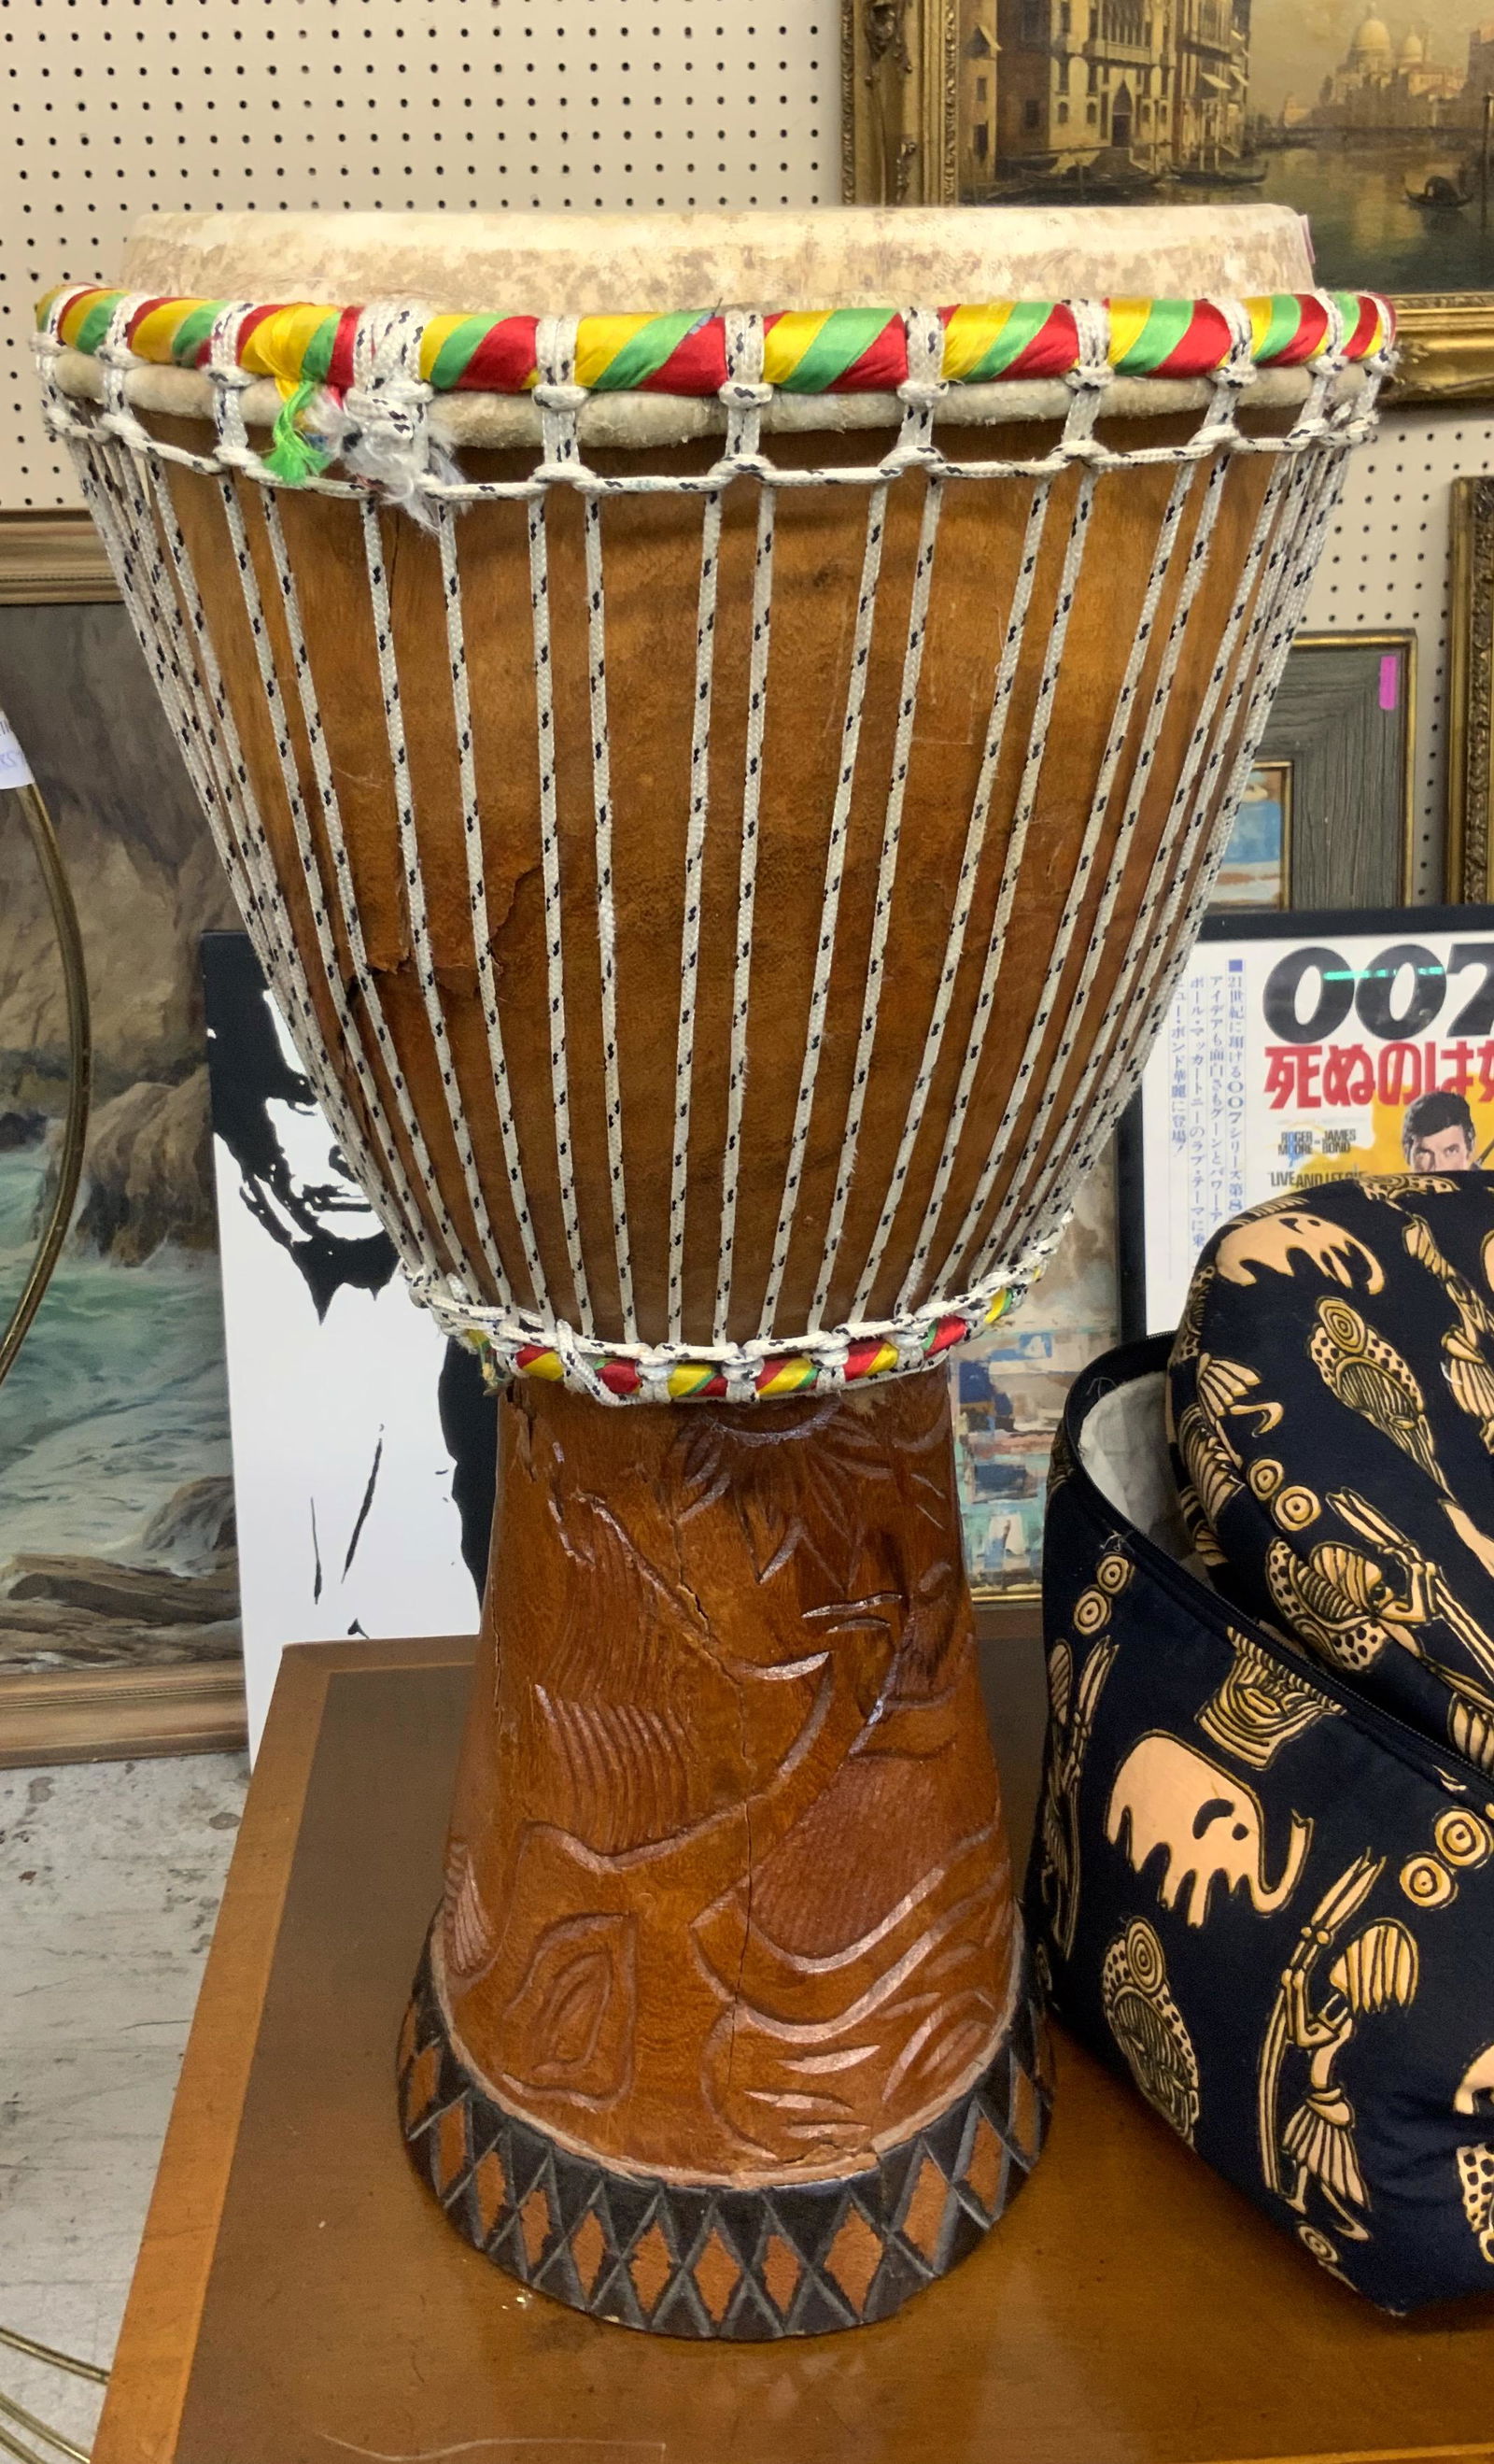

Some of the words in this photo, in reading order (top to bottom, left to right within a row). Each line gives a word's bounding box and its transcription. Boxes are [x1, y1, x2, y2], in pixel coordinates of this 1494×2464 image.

[1262, 943, 1494, 1045] 007
[1227, 976, 1244, 1218] 21世紀に翔ける007シリーズ第8
[1280, 1131, 1313, 1144] ROGER
[1324, 1128, 1357, 1141] JAMES
[1277, 1143, 1313, 1155] MOORE
[1321, 1140, 1351, 1154] BOND
[1271, 1171, 1295, 1187] LIVE
[1296, 1173, 1323, 1188] AND
